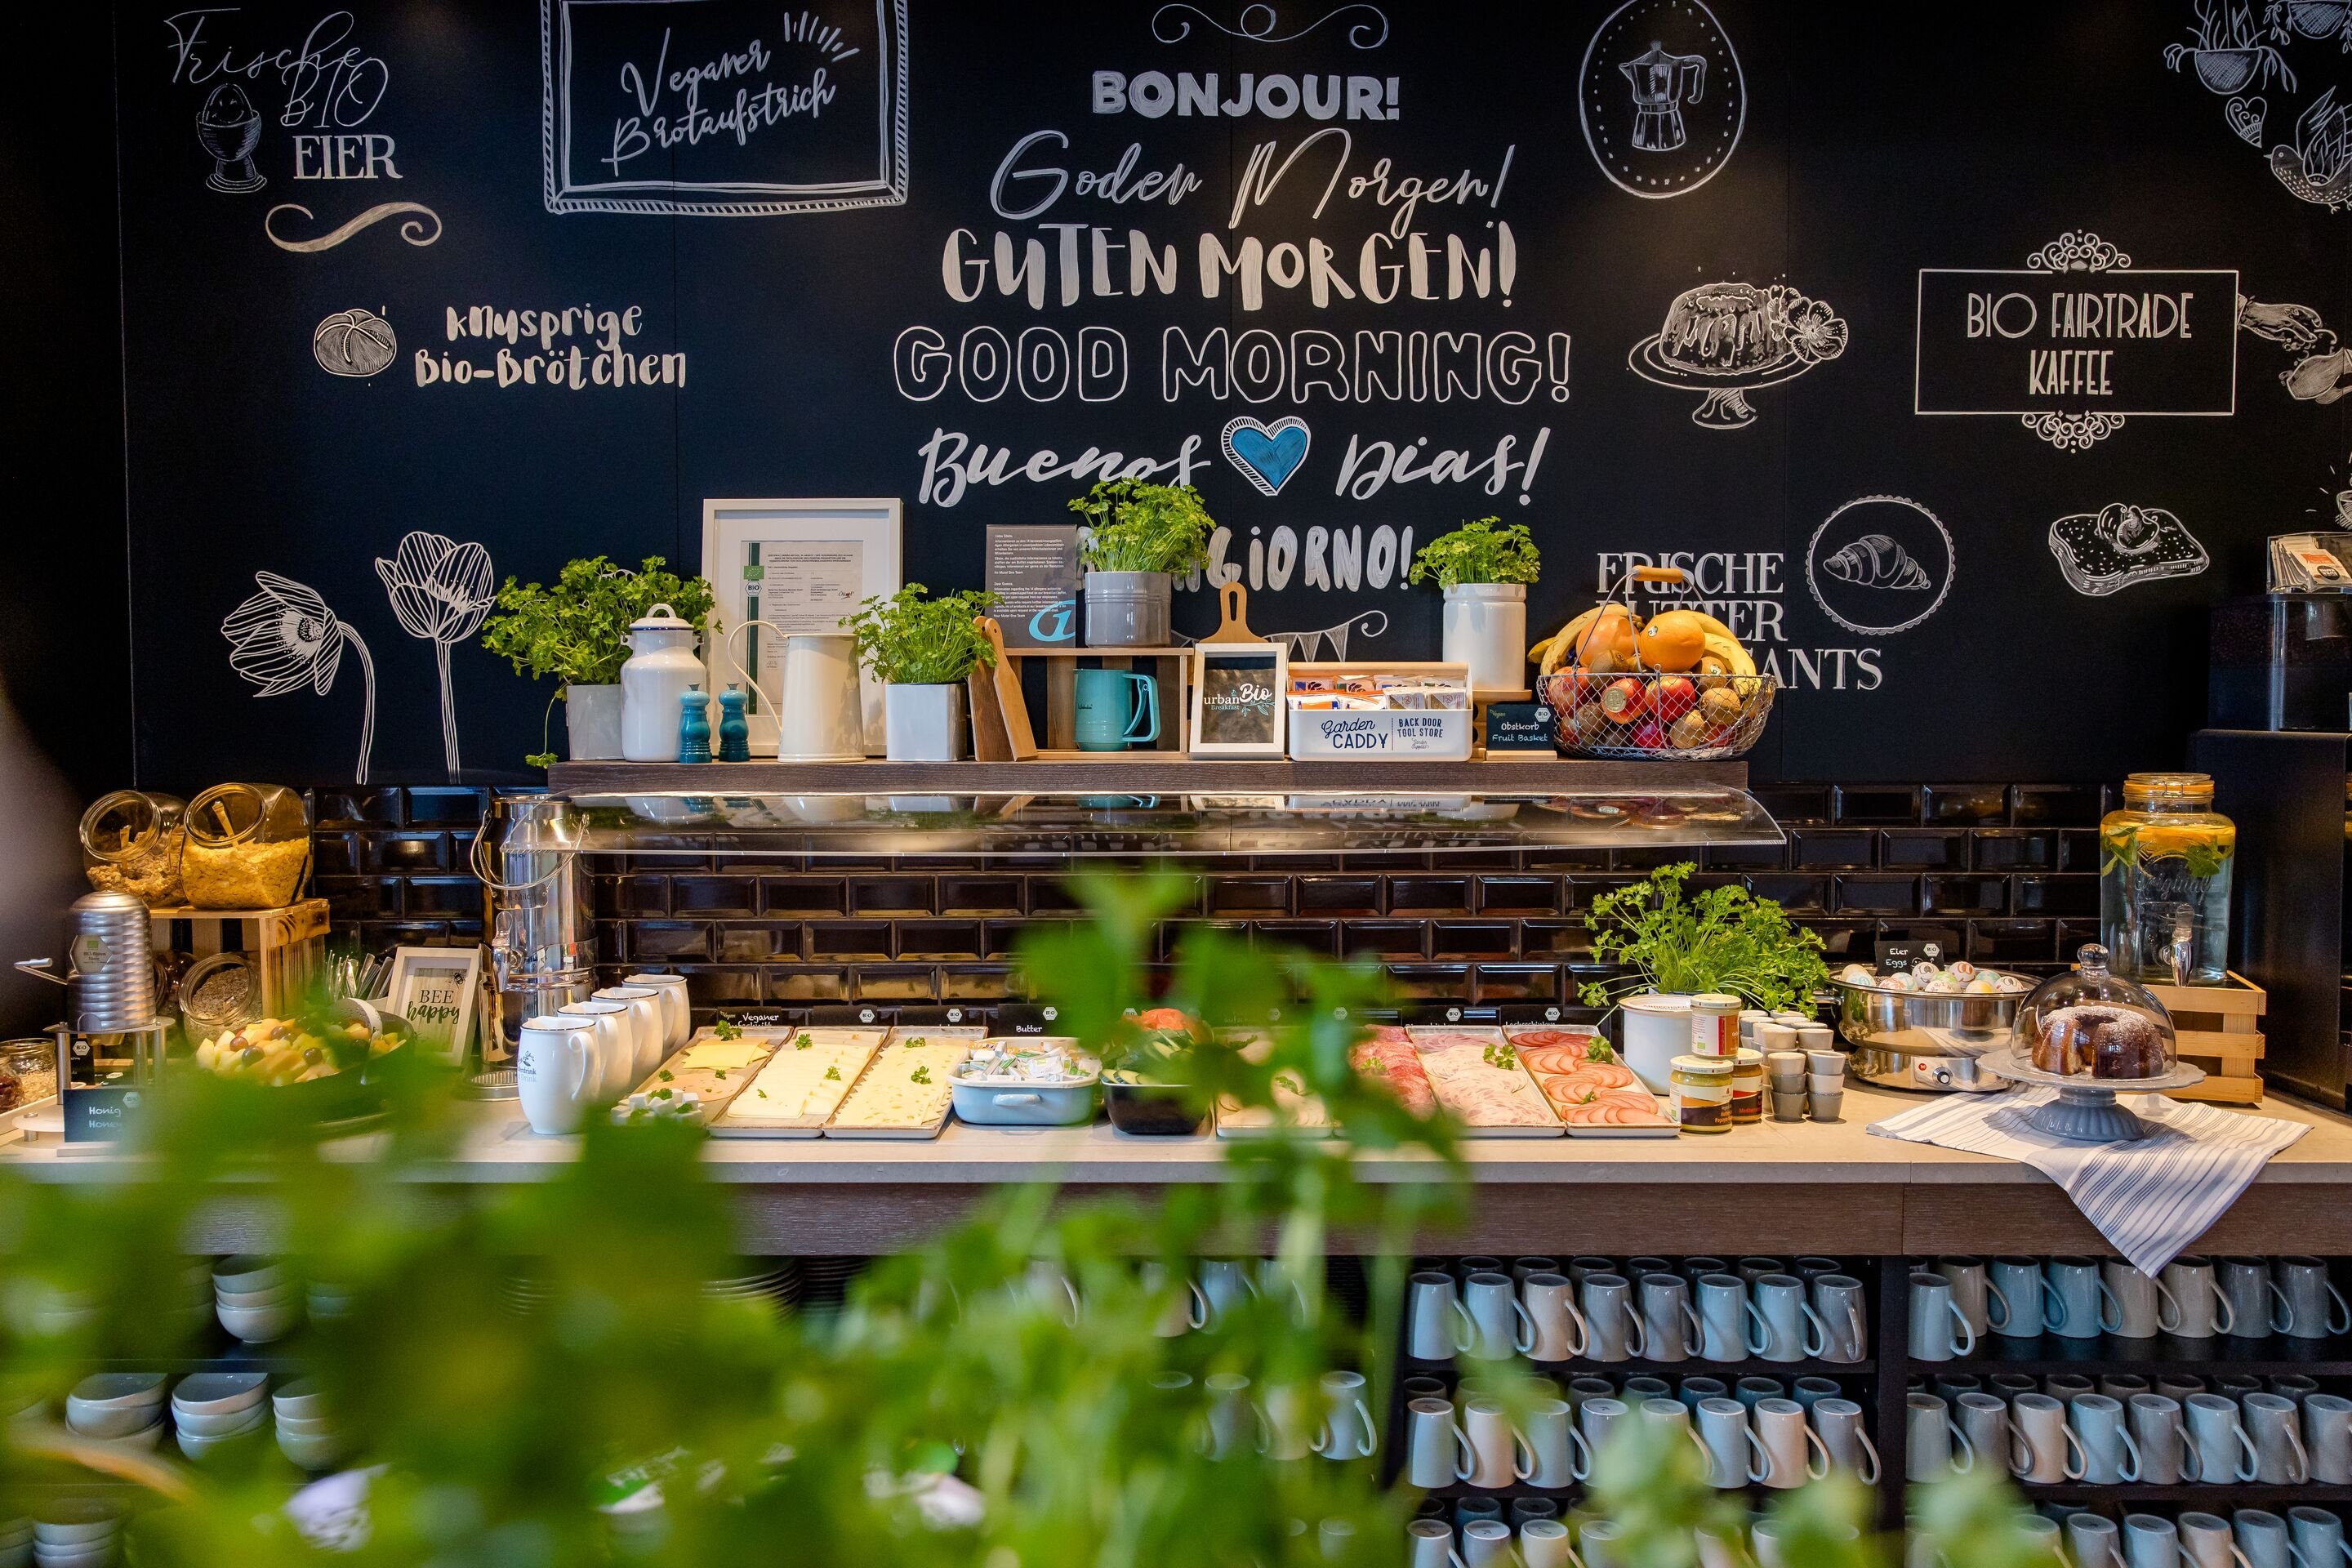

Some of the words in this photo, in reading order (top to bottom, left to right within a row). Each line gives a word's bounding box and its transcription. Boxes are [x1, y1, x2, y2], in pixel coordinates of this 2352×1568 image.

[163, 7, 361, 83] Frische
[621, 28, 771, 117] Veganer
[280, 57, 388, 128] BIO
[1092, 70, 1400, 121] BONJOUR!
[601, 68, 836, 176] Brotaufstrich
[292, 134, 403, 180] EIER
[990, 128, 1203, 220] Goden
[1228, 128, 1516, 240] Morgen!
[942, 222, 1177, 311] GUTEN
[1199, 220, 1517, 311] MORGEN!
[1967, 292, 2038, 339] BIO
[2051, 292, 2194, 339] FAIRTRADE
[414, 346, 686, 390] Bio-Brötchen
[893, 326, 1127, 403] GOOD
[1162, 327, 1571, 405] MORNING!
[2029, 350, 2114, 395] KAFFEE
[919, 426, 1211, 507] Buenos
[1336, 426, 1552, 506] Dias!
[1597, 551, 1784, 595] FRISCHE
[1203, 693, 1240, 705] urban
[1239, 683, 1272, 702] Bio
[1321, 718, 1375, 739] Garden
[1397, 728, 1416, 738] TOOL
[1419, 728, 1443, 738] STORE
[1398, 718, 1419, 728] BACK
[1422, 717, 1442, 728] DOOR
[1501, 721, 1539, 731] Obstkorb
[1517, 733, 1548, 742] Basket
[1332, 733, 1388, 749] CADDY
[1886, 959, 1907, 969] Eggs
[406, 1001, 460, 1024] happy
[419, 989, 454, 1004] BEE
[742, 1013, 780, 1023] Veganer
[1016, 1025, 1043, 1033] Butter
[88, 1106, 121, 1117] Honig
[88, 1120, 122, 1131] Hone
